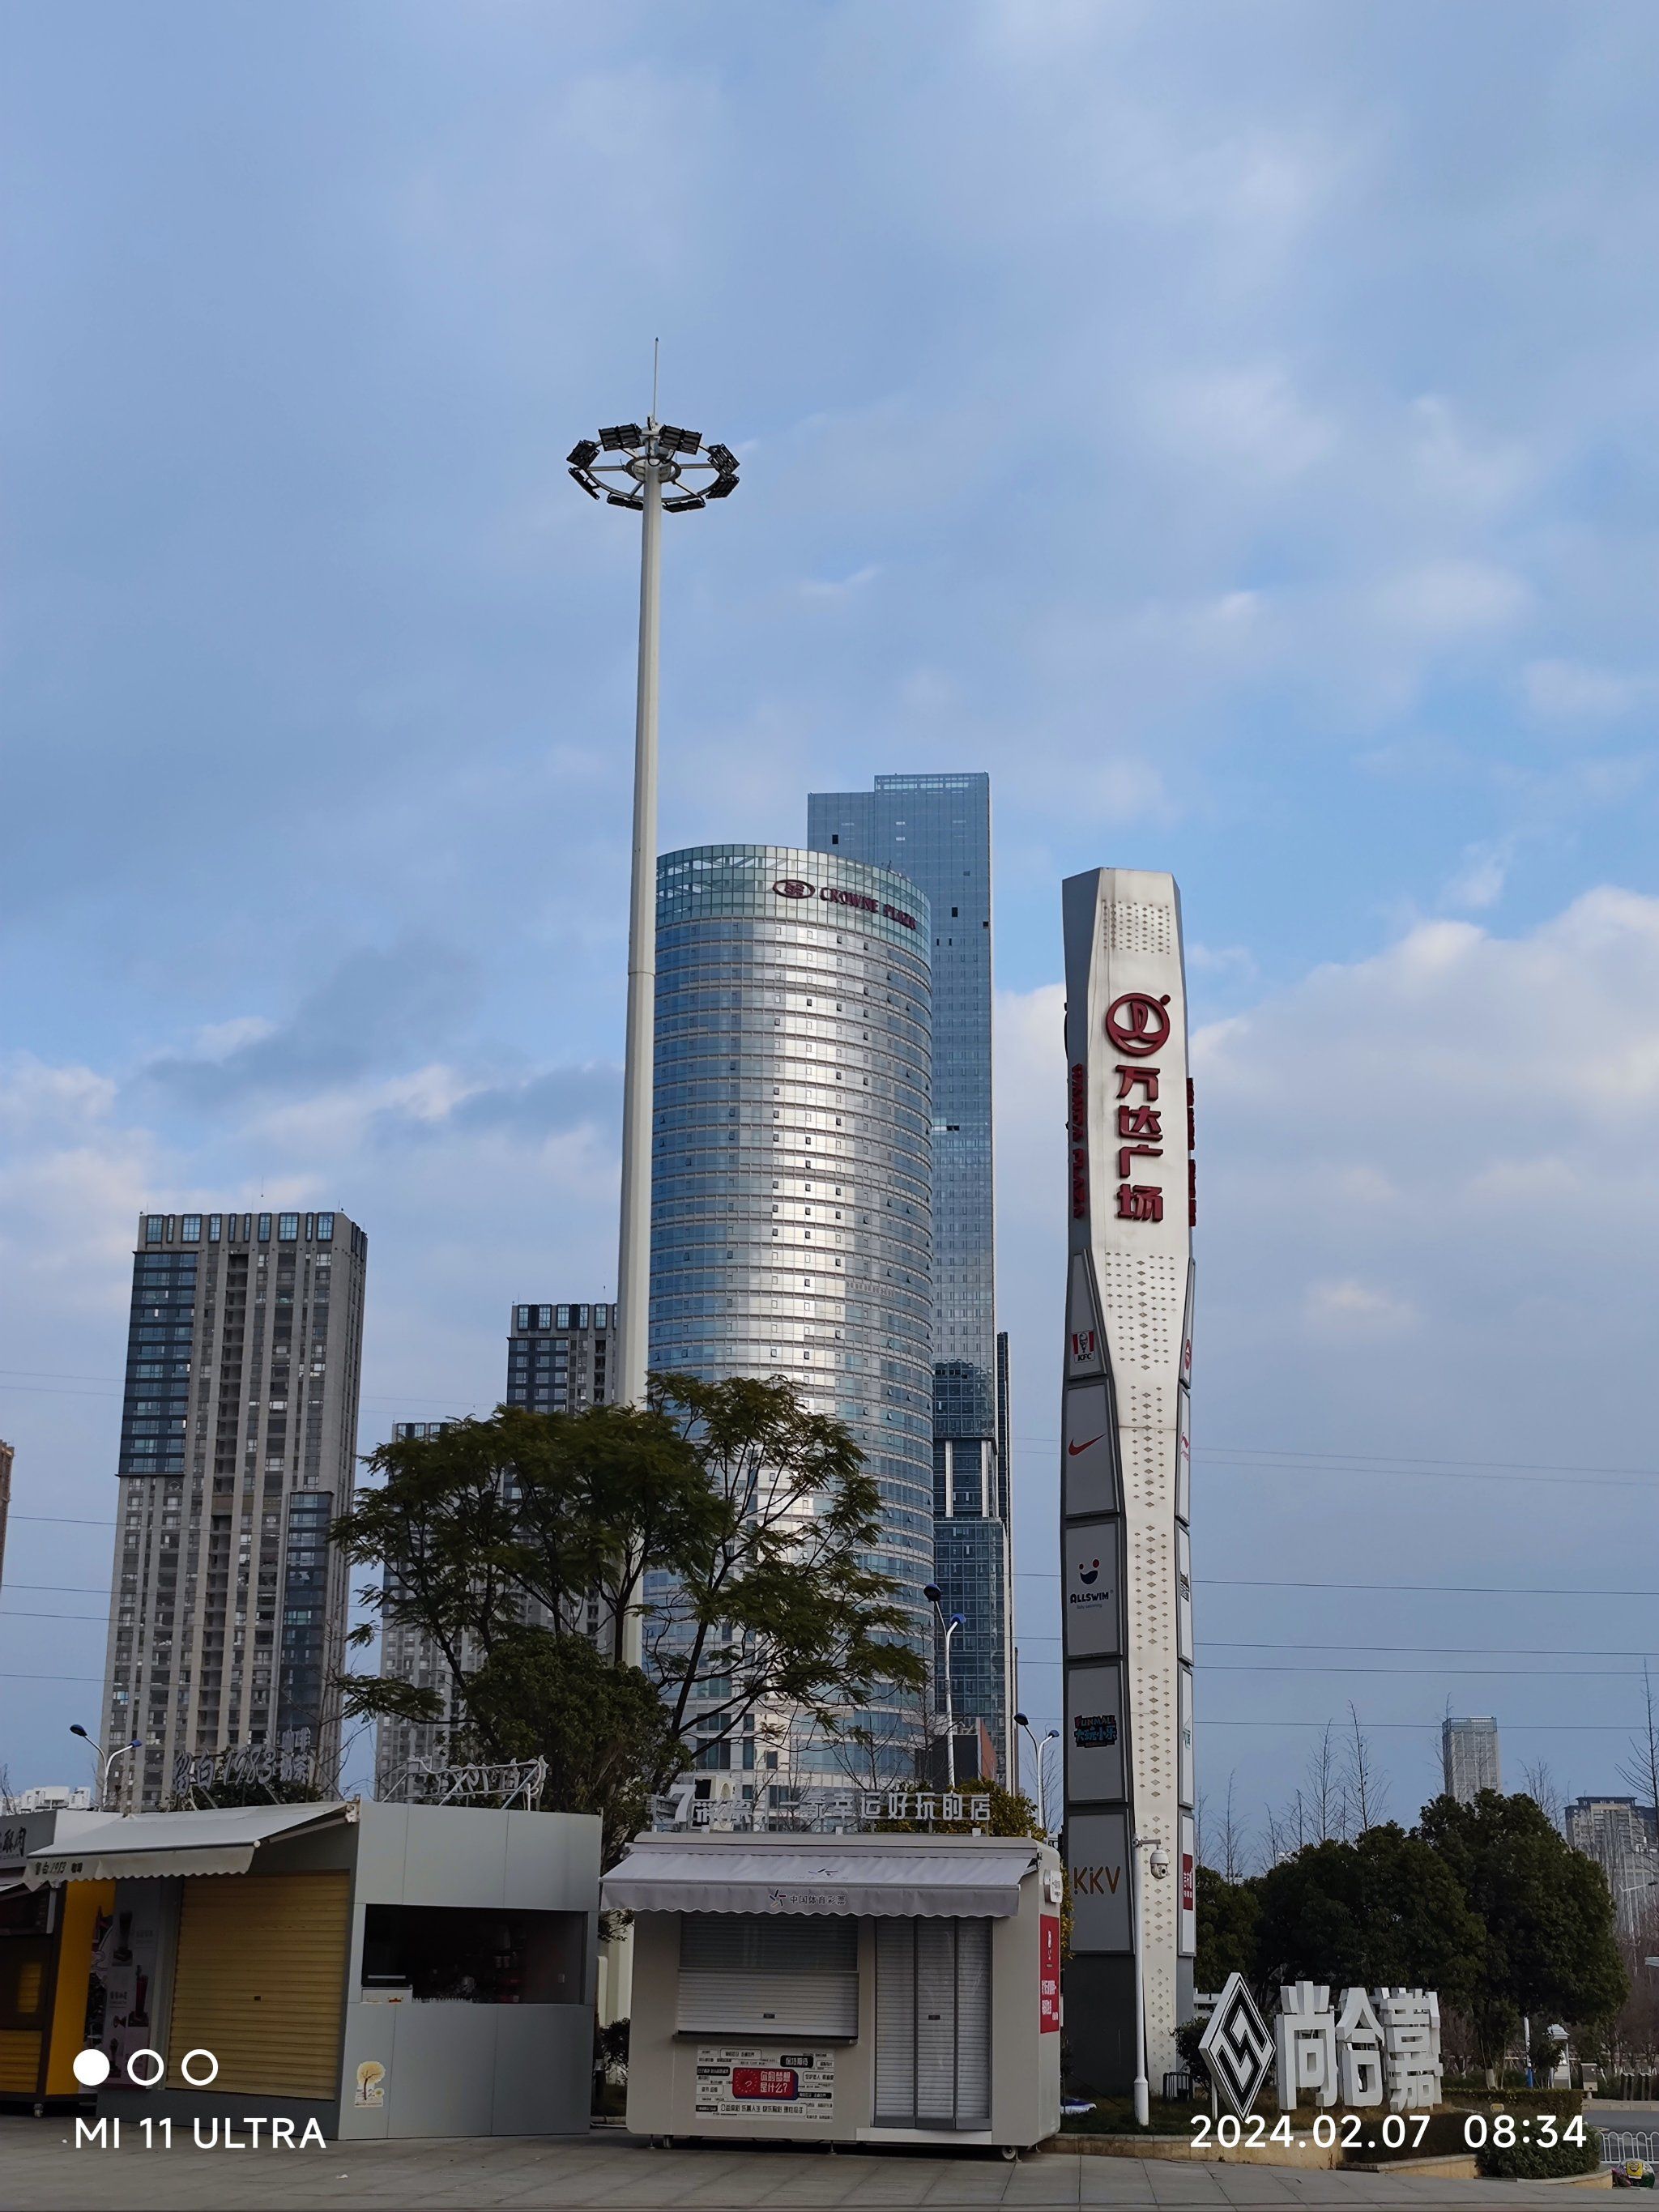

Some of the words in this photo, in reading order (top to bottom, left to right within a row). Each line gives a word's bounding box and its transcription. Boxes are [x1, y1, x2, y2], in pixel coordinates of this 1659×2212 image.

[820, 887, 879, 913] CROWNE
[1115, 1064, 1163, 1223] 万达广场
[1077, 1353, 1092, 1362] KFC
[1069, 1592, 1109, 1604] ALLSWIM
[778, 1791, 990, 1821] 一家幸运好玩的店
[790, 1895, 846, 1905] 中国体育彩票
[760, 2071, 791, 2082] 你的梦想
[760, 2082, 789, 2094] 是什么?
